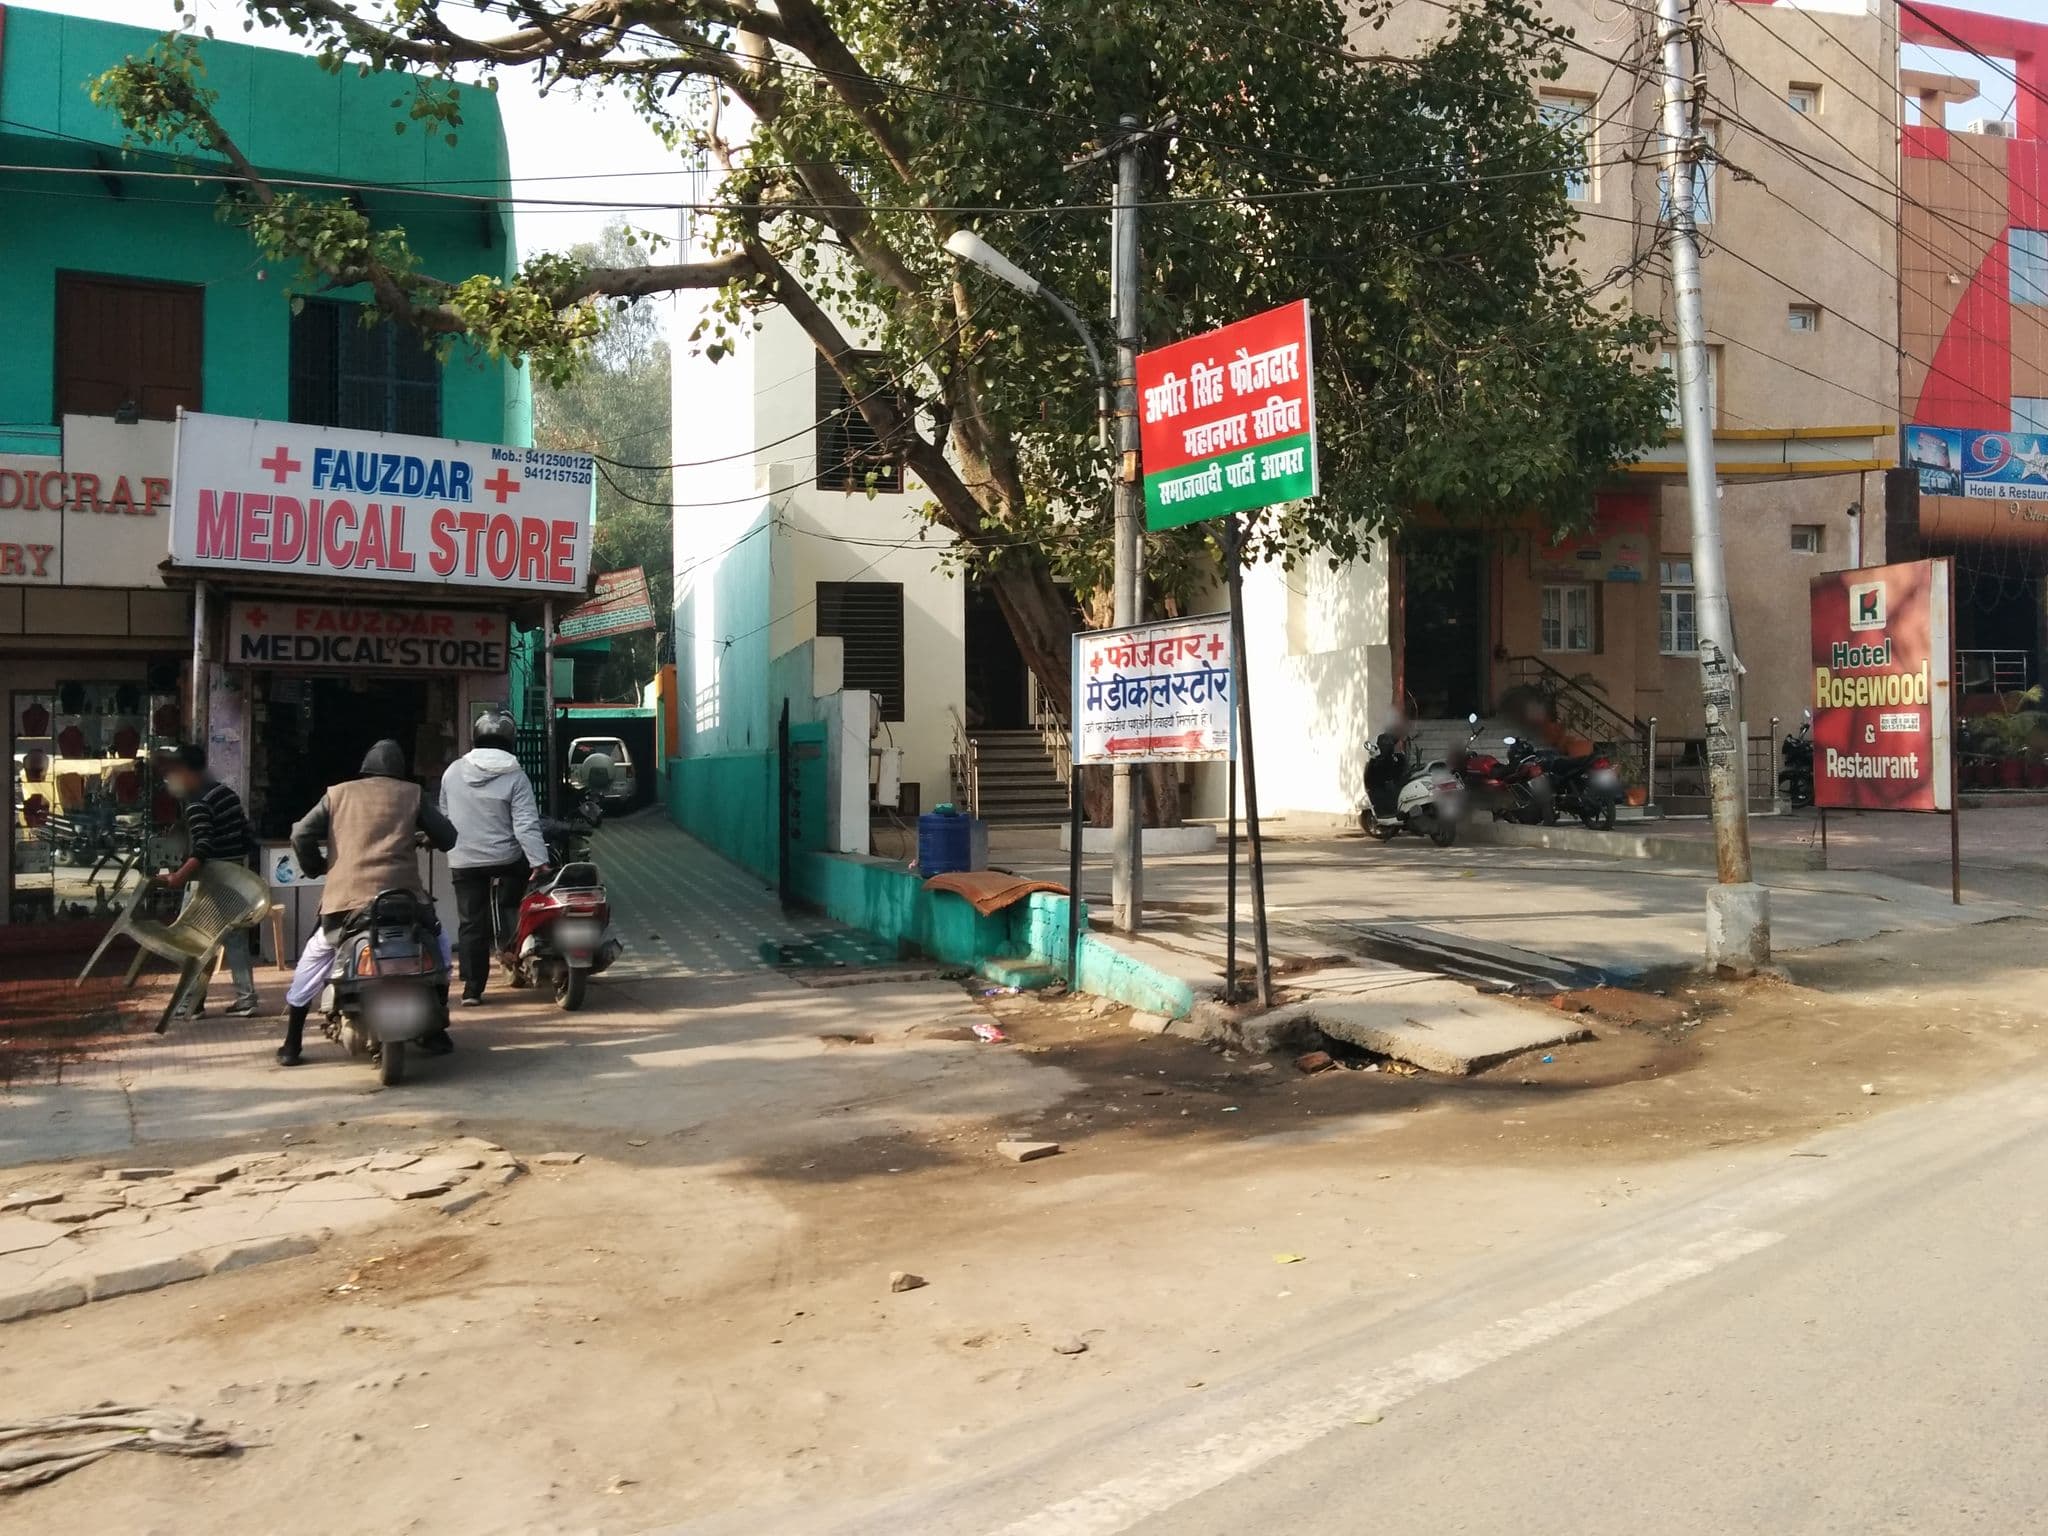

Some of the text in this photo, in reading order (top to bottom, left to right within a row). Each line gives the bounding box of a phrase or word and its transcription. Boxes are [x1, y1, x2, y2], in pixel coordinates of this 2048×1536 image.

[1145, 372, 1187, 424] अमीर
[1190, 357, 1224, 409] सिंह
[1183, 395, 1302, 457] महानगर सचिव
[312, 447, 472, 503] FAUZDAR
[492, 448, 593, 470] Mob.: 9412500122
[524, 467, 592, 484] 9412157520
[1158, 447, 1304, 505] समाजवादी पार्टी आगरा
[1970, 484, 2048, 500] Hotel & Restaur
[196, 489, 578, 583] MEDICAL STORE
[296, 608, 453, 635] FAUZDAR
[241, 634, 504, 668] MEDICAL STORE
[1832, 637, 1891, 670] Hotel
[1816, 659, 1928, 709] Rosewood
[1865, 724, 1876, 743] &
[1826, 748, 1919, 779] Restaurant
